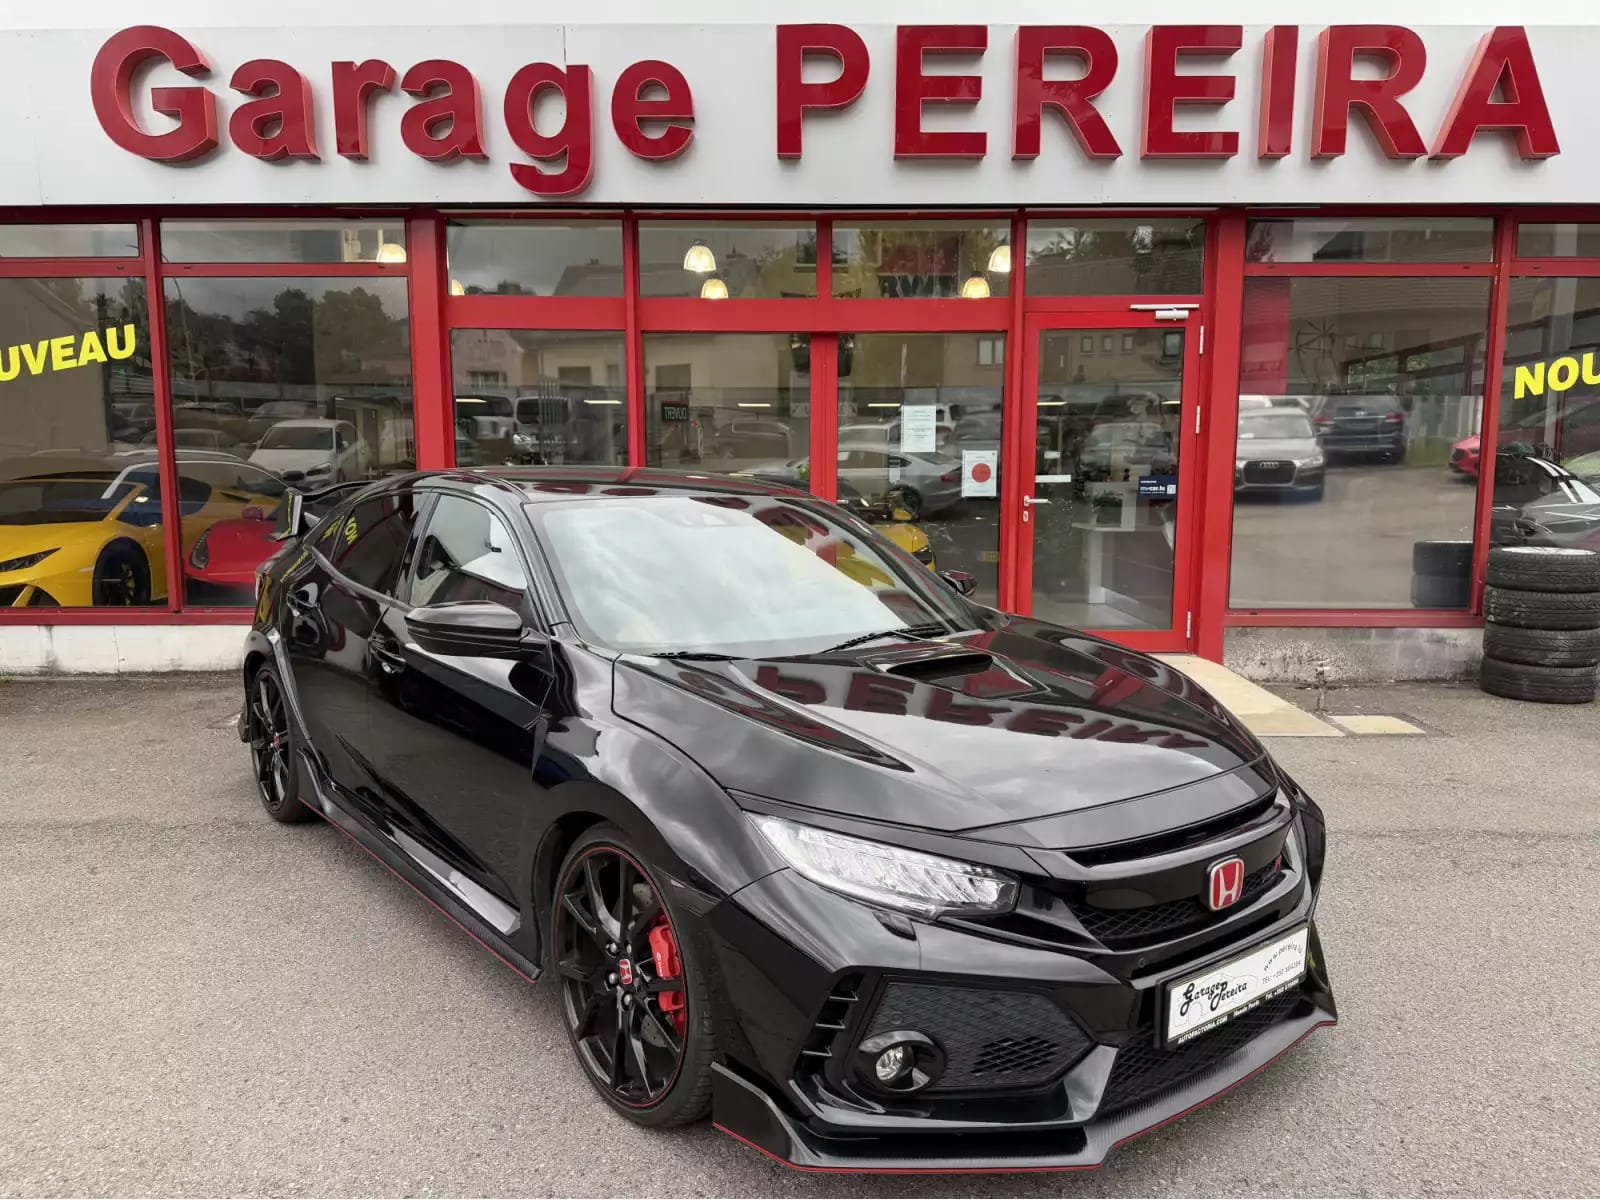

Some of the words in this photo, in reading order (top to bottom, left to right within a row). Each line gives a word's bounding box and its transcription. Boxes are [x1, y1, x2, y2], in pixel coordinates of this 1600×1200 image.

[91, 25, 695, 198] Garage
[775, 24, 1560, 162] PEREIRA
[1180, 982, 1221, 1016] Garage
[1210, 981, 1248, 1012] Pereira
